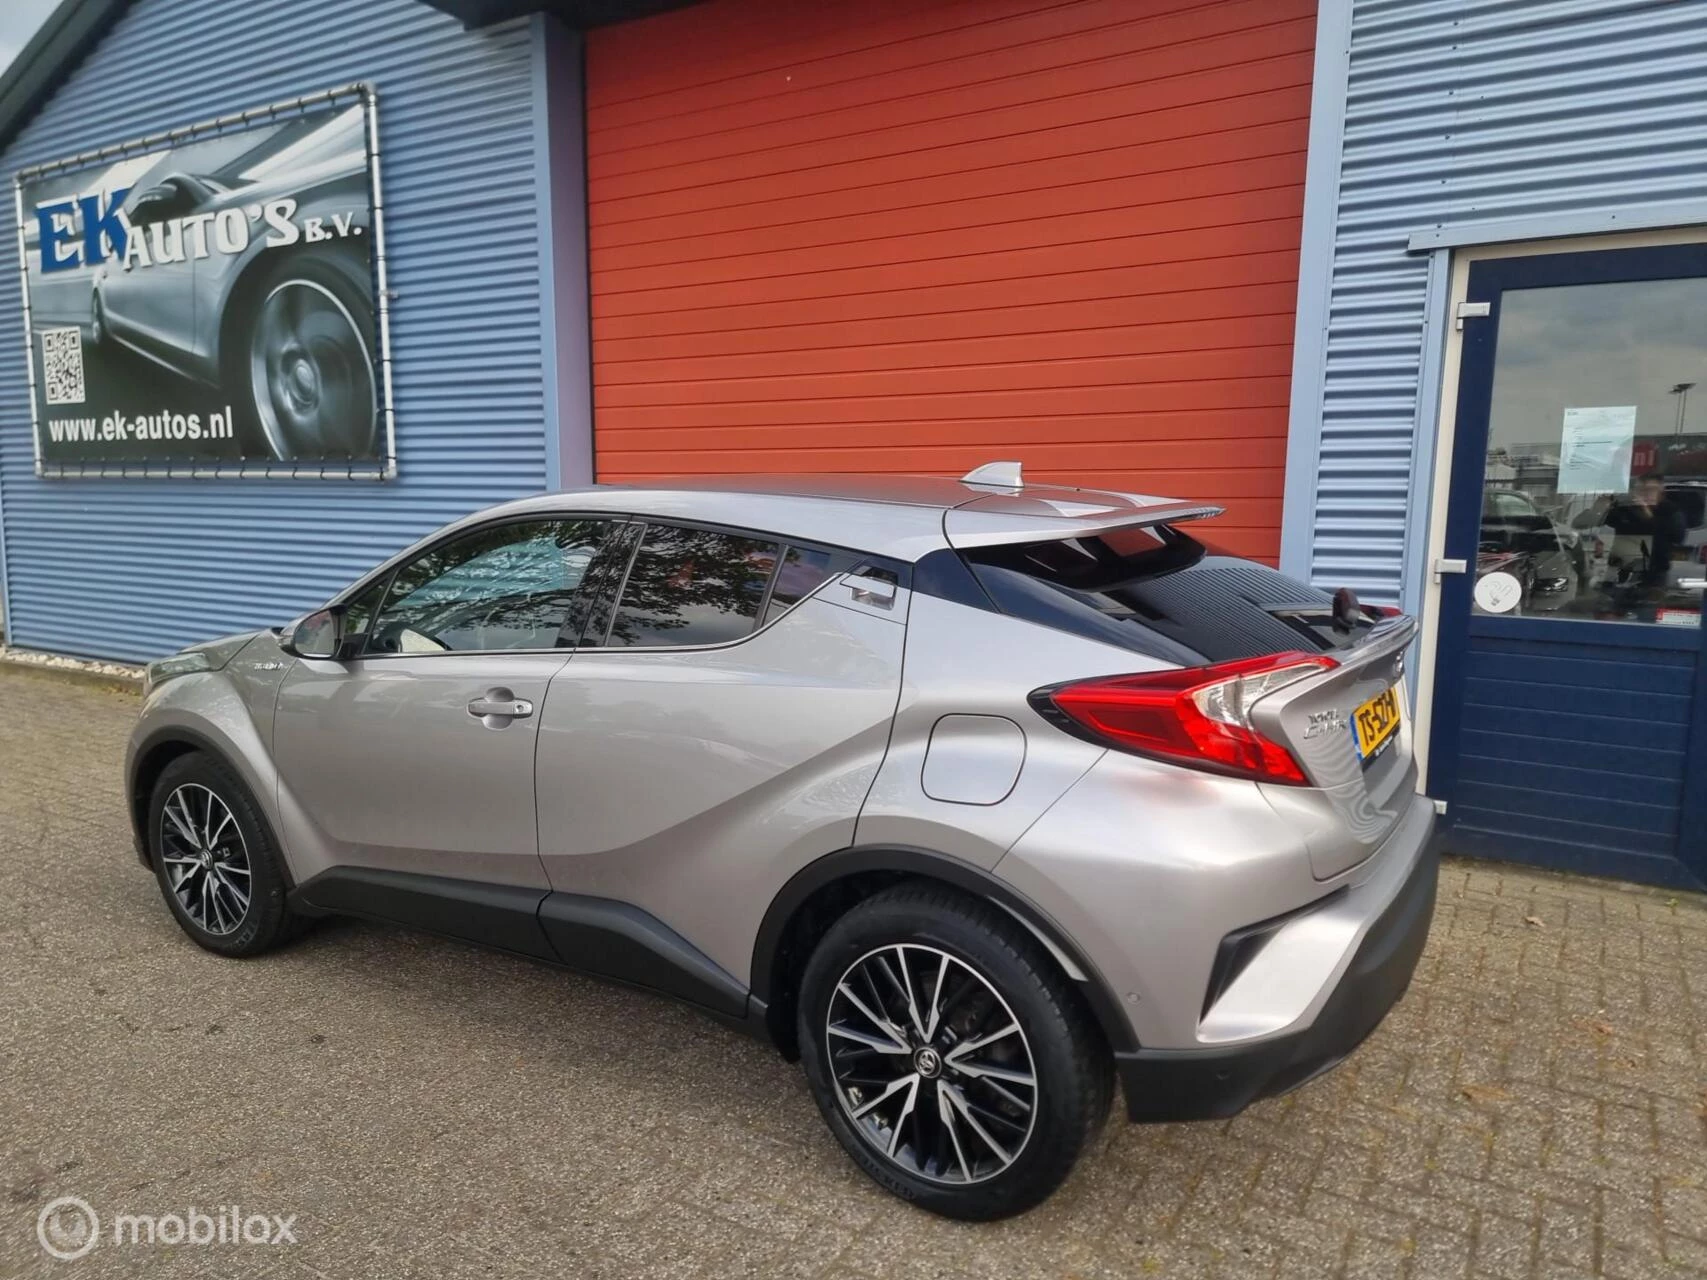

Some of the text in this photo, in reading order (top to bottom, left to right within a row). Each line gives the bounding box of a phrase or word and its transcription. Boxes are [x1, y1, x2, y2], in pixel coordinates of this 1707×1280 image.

[36, 187, 362, 273] EK AUTO'S B.V.
[49, 405, 234, 442] www.ek-autos.nl
